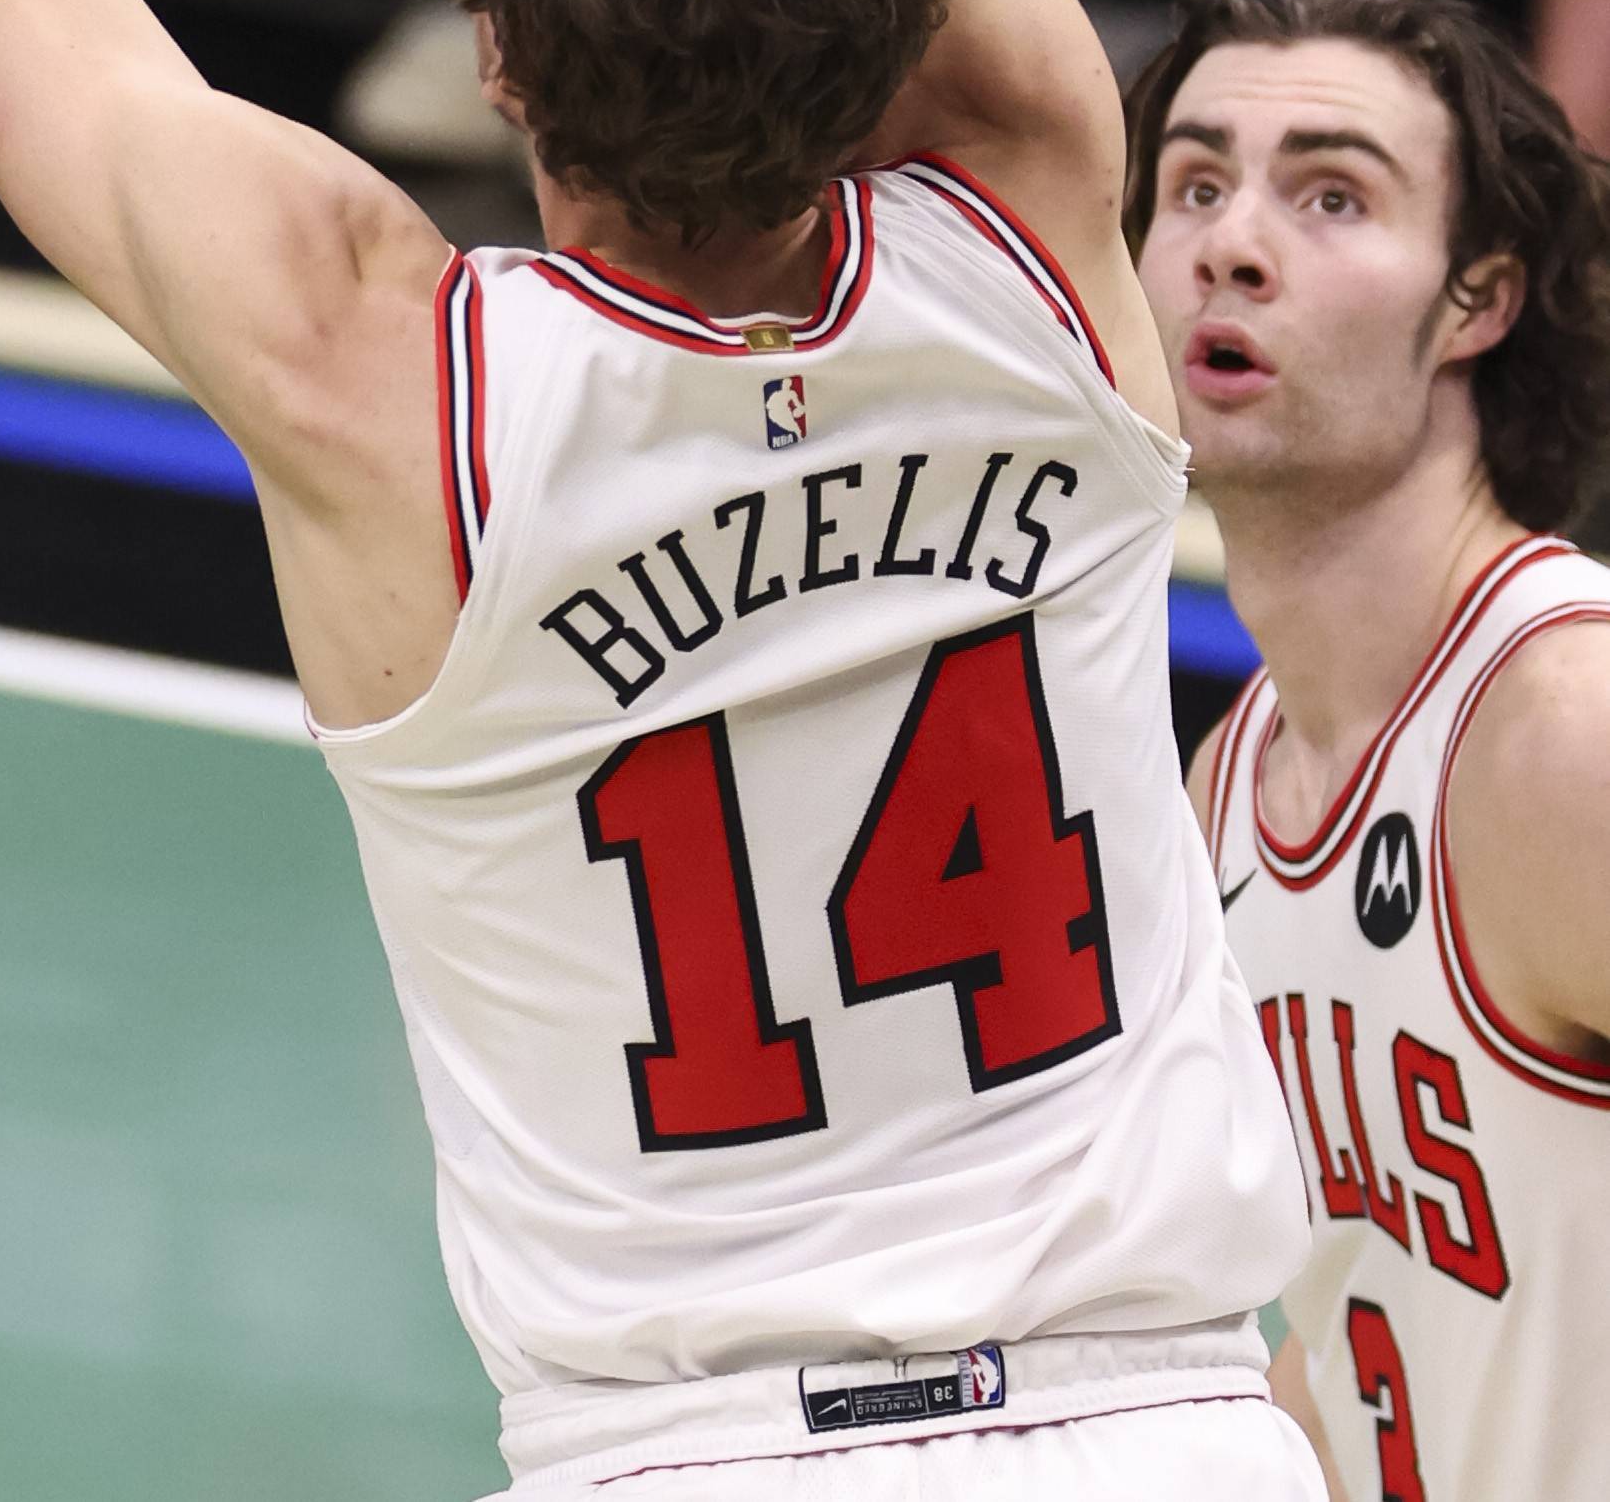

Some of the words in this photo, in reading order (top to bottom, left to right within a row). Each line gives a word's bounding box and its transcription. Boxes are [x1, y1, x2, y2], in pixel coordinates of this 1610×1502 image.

[772, 433, 793, 449] NBA
[538, 452, 1078, 709] BUZELIS
[576, 609, 1124, 1153] 14
[933, 1385, 954, 1402] 38
